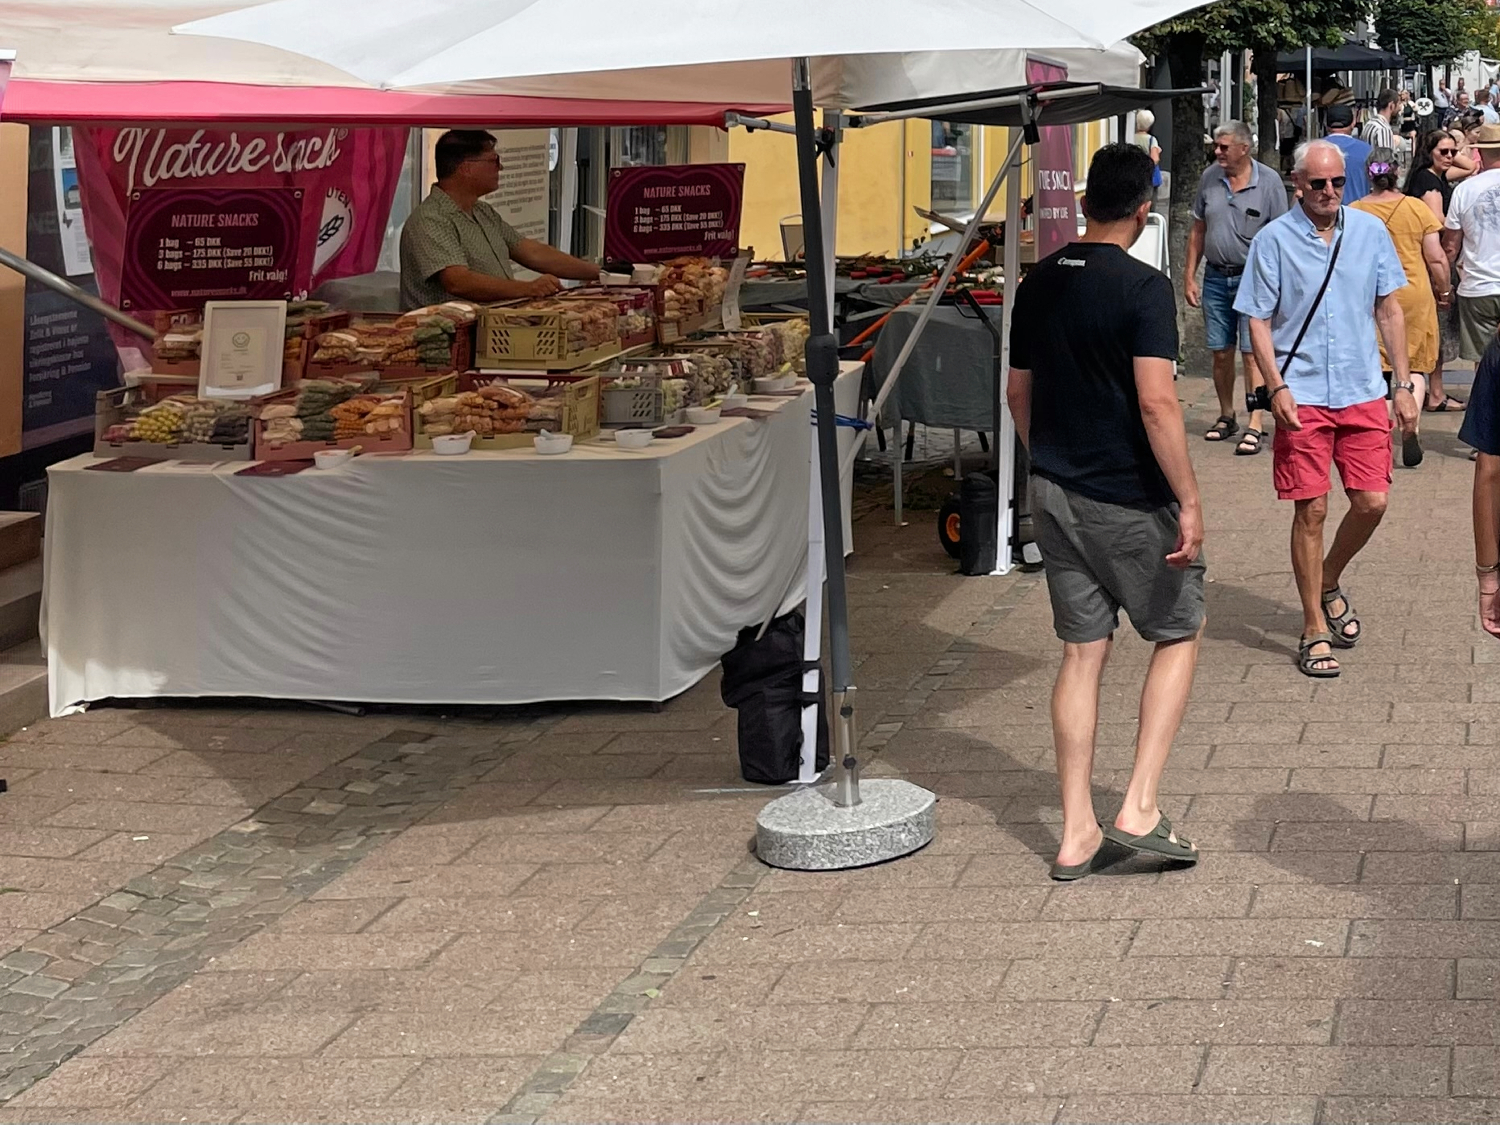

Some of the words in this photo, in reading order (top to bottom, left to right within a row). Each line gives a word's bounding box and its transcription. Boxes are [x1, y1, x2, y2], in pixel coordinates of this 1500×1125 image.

[113, 127, 271, 197] Nature
[643, 186, 676, 198] NATURE
[678, 184, 711, 197] SNACKS
[639, 207, 650, 216] bag
[670, 205, 682, 213] DKK
[171, 214, 215, 228] NATURE
[218, 213, 259, 227] SNACKS
[639, 216, 653, 225] bags
[670, 214, 682, 222] DKK
[639, 225, 653, 234] bags
[671, 223, 683, 231] DKK
[165, 238, 180, 249] bag
[195, 237, 205, 247] 65
[206, 237, 221, 247] DKK
[165, 249, 183, 260] bags
[193, 248, 206, 258] 175
[207, 248, 221, 258] DKK
[223, 246, 242, 258] (Save
[253, 245, 273, 256] DKK!)
[164, 260, 183, 272] bags
[191, 259, 207, 269] 335
[208, 259, 223, 269] DKK
[223, 257, 242, 269] (Save
[253, 256, 274, 267] DKK!)
[266, 269, 288, 283] valg!
